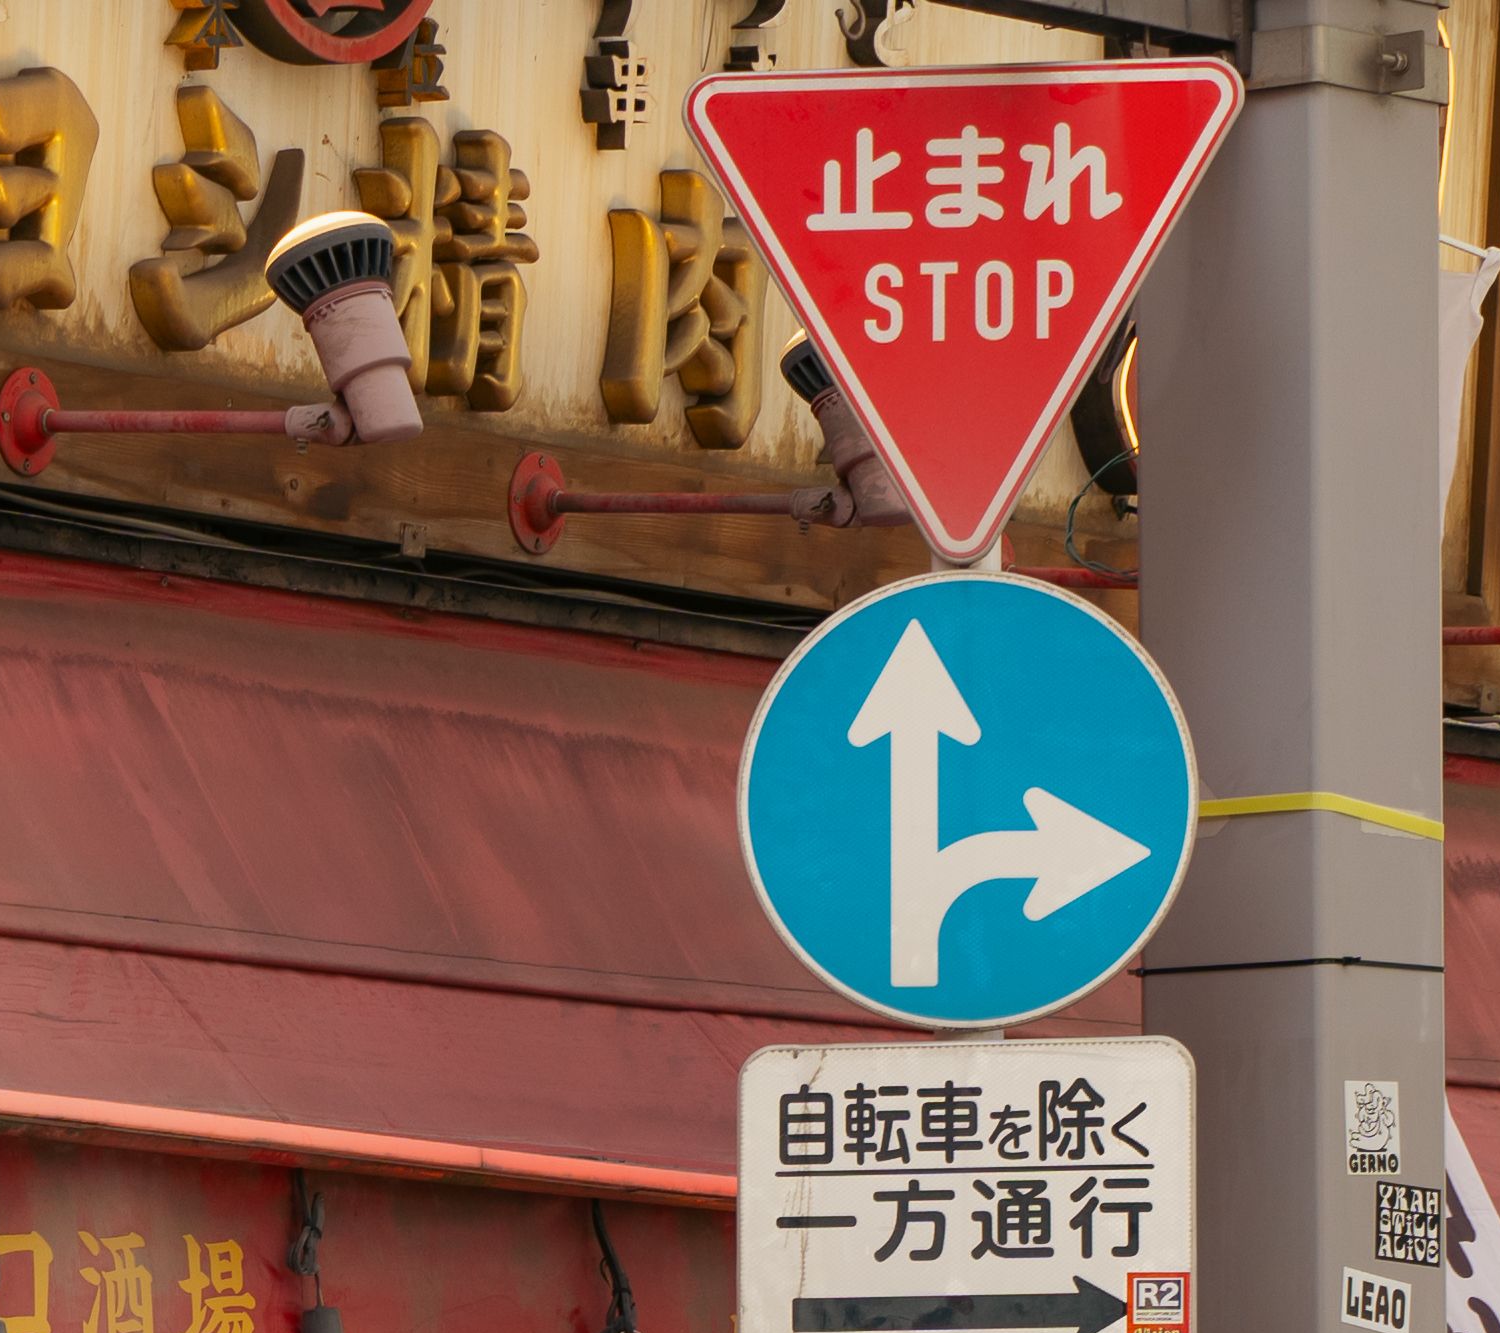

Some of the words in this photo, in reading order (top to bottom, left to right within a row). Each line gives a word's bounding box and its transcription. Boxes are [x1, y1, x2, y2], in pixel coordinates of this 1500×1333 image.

[806, 122, 1123, 230] 止まれ
[863, 259, 1076, 343] STOP
[779, 1077, 1151, 1165] 自転車を除く
[775, 1176, 1153, 1262] 一方通行
[1138, 1282, 1180, 1308] R2
[1346, 1276, 1406, 1330] LEAO
